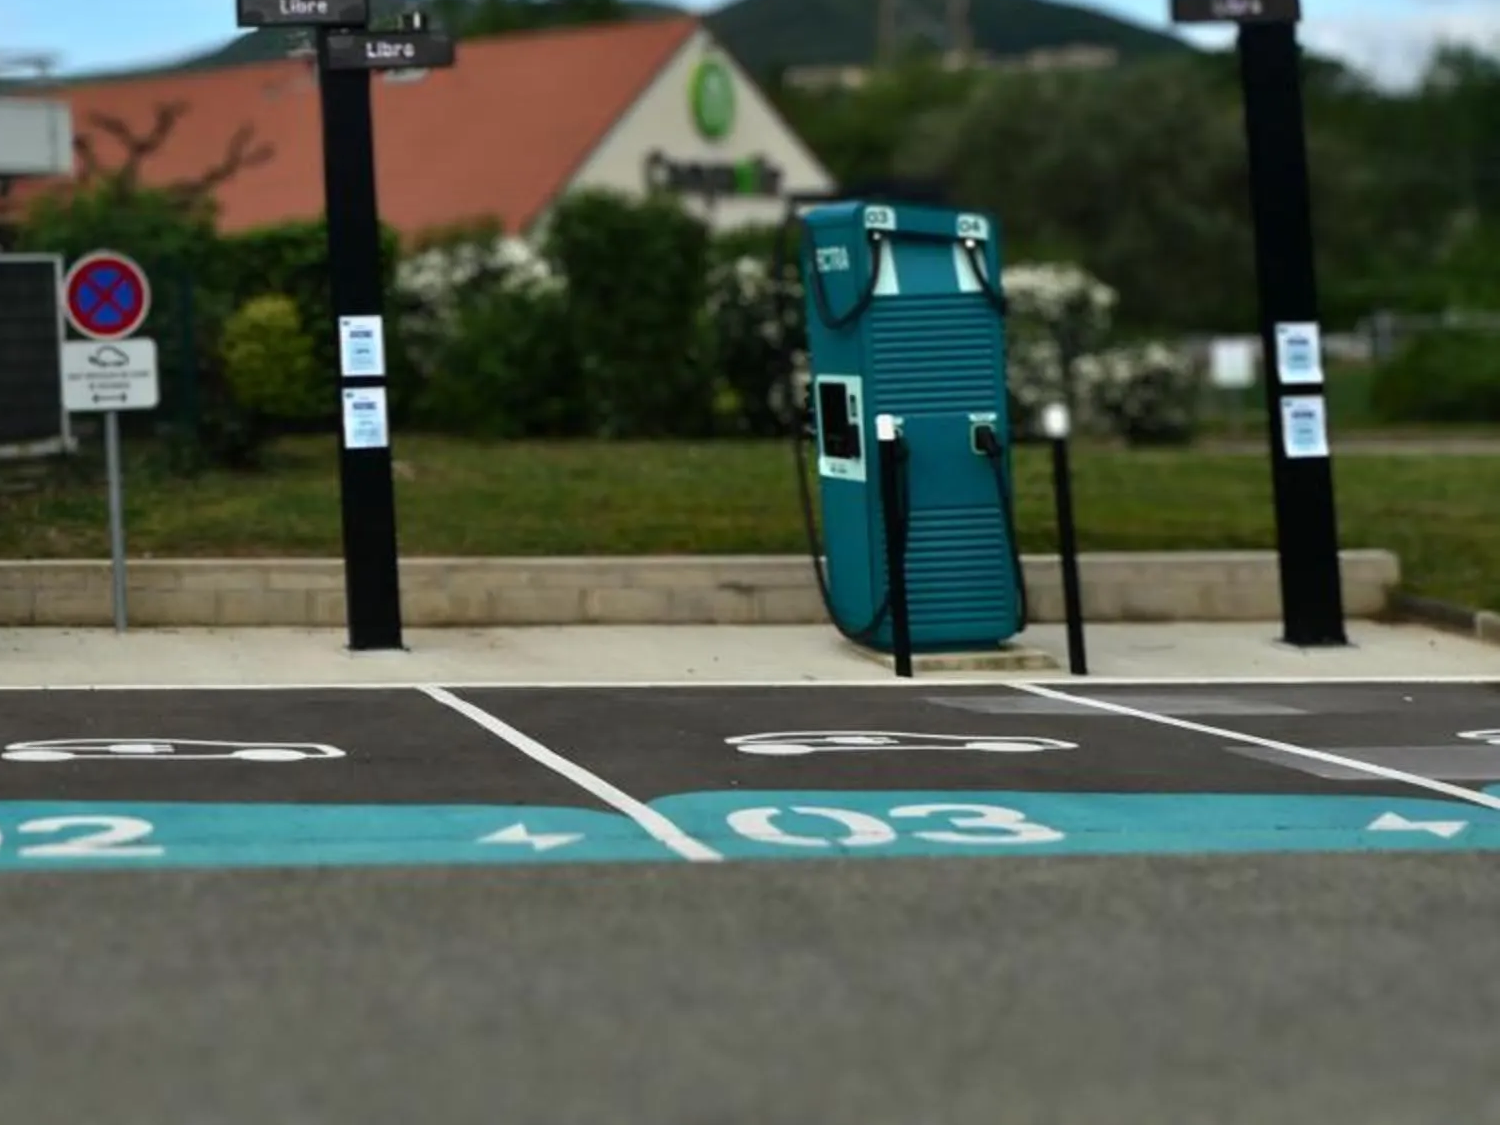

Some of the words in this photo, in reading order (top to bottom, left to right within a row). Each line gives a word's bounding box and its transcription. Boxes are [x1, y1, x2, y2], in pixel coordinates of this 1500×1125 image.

[366, 42, 415, 59] Libre
[867, 211, 888, 223] 03
[726, 804, 1067, 848] 03
